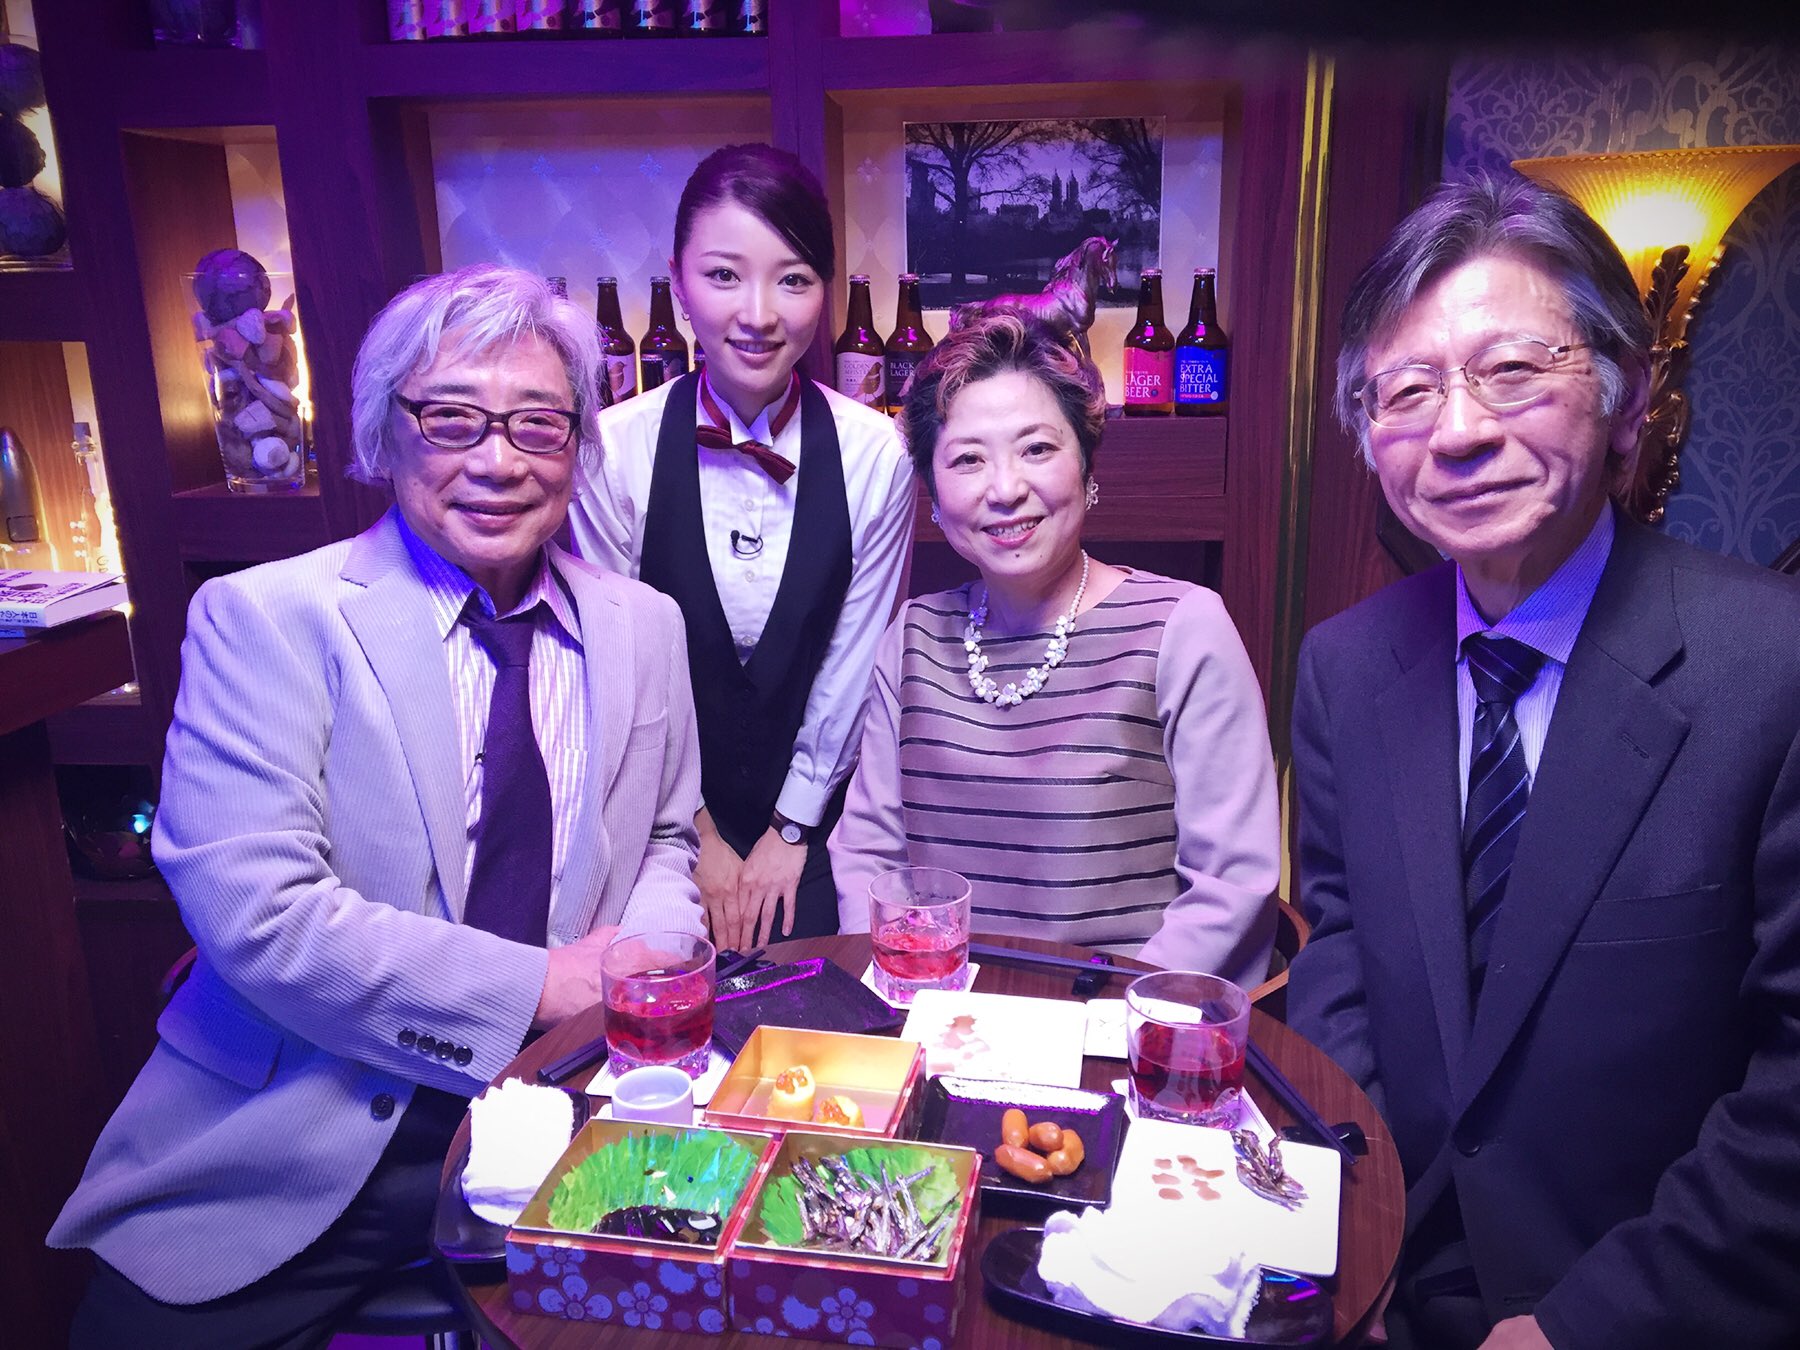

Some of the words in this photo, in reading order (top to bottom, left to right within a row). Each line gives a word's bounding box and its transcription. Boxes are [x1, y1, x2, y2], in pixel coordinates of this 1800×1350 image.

[1180, 364, 1213, 374] EXTRA
[1125, 374, 1162, 386] LAGER
[1179, 373, 1218, 383] SPECIAL
[1125, 386, 1151, 398] BEER
[1179, 383, 1211, 393] BITTER
